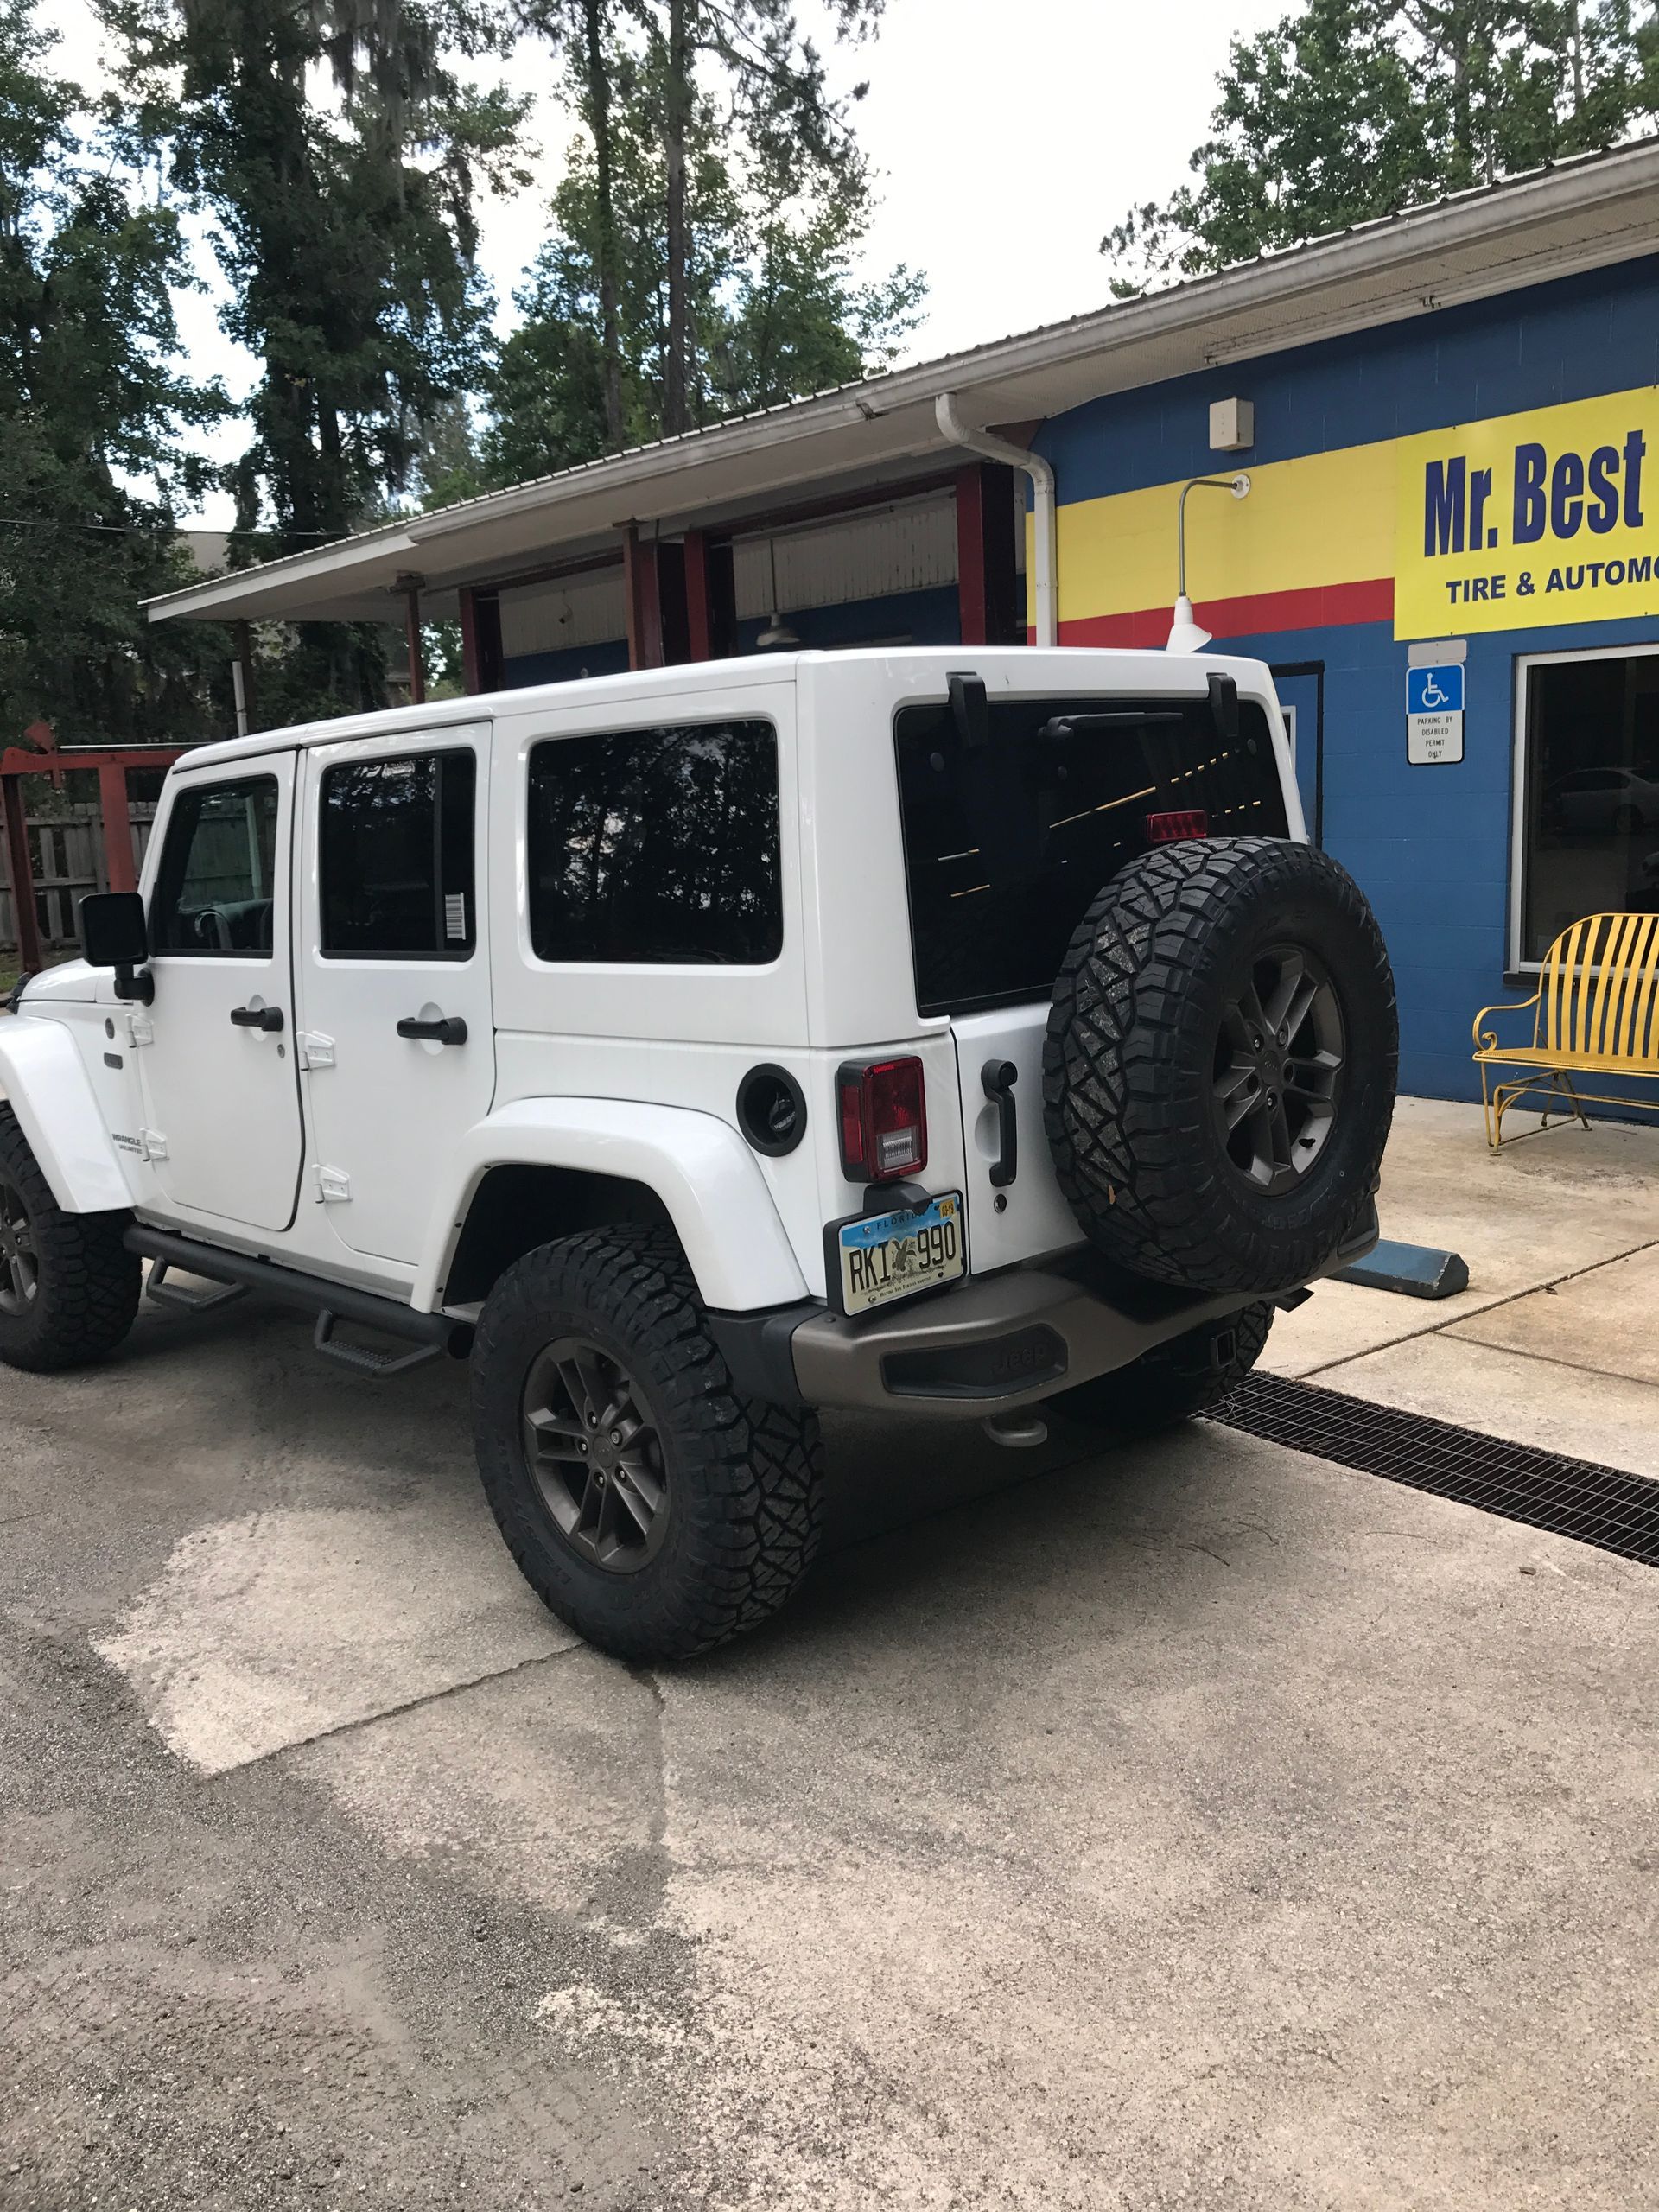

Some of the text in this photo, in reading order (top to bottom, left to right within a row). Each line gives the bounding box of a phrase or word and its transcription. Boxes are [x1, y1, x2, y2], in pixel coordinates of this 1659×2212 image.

[1424, 429, 1647, 558] Mr. Best
[1446, 556, 1659, 605] TIRE & AUTOM
[1417, 717, 1441, 726] PARKING
[1421, 728, 1449, 736] DISABLED
[876, 1212, 925, 1230] FLORID
[849, 1220, 957, 1294] RKI 990
